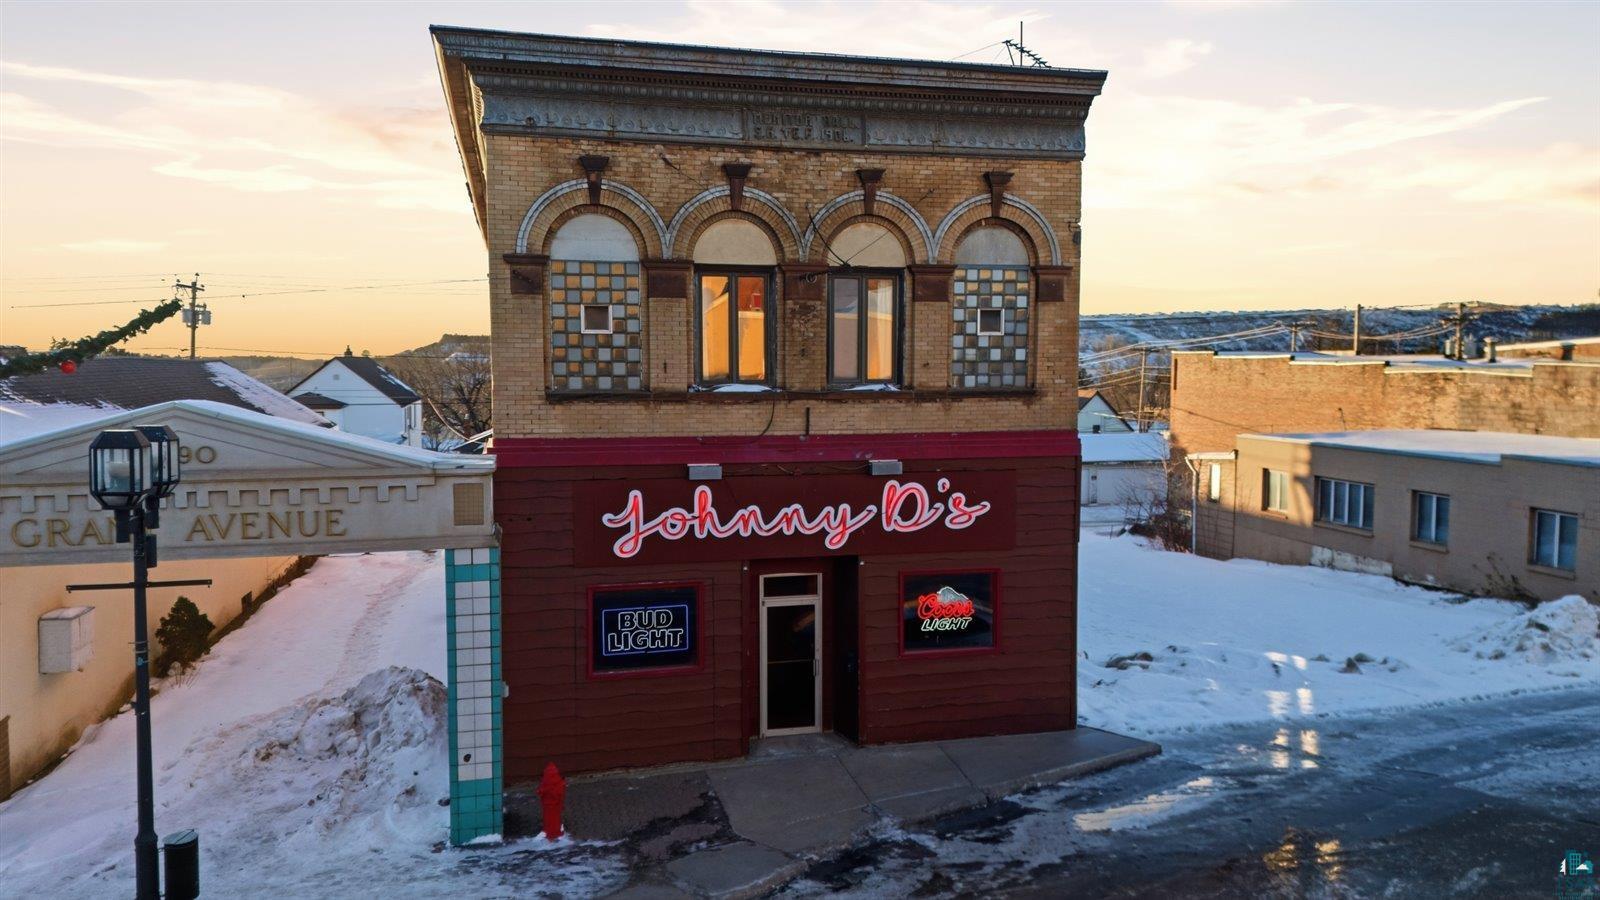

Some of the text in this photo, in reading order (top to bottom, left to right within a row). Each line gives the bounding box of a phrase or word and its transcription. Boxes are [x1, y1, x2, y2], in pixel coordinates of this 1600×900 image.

[179, 446, 216, 464] 90
[11, 510, 347, 547] GRA AVENUE
[602, 478, 991, 558] Johnny D's
[918, 593, 975, 620] Coors
[618, 609, 673, 630] BUD
[921, 617, 972, 631] LIGHT
[608, 629, 684, 652] LIGHT
